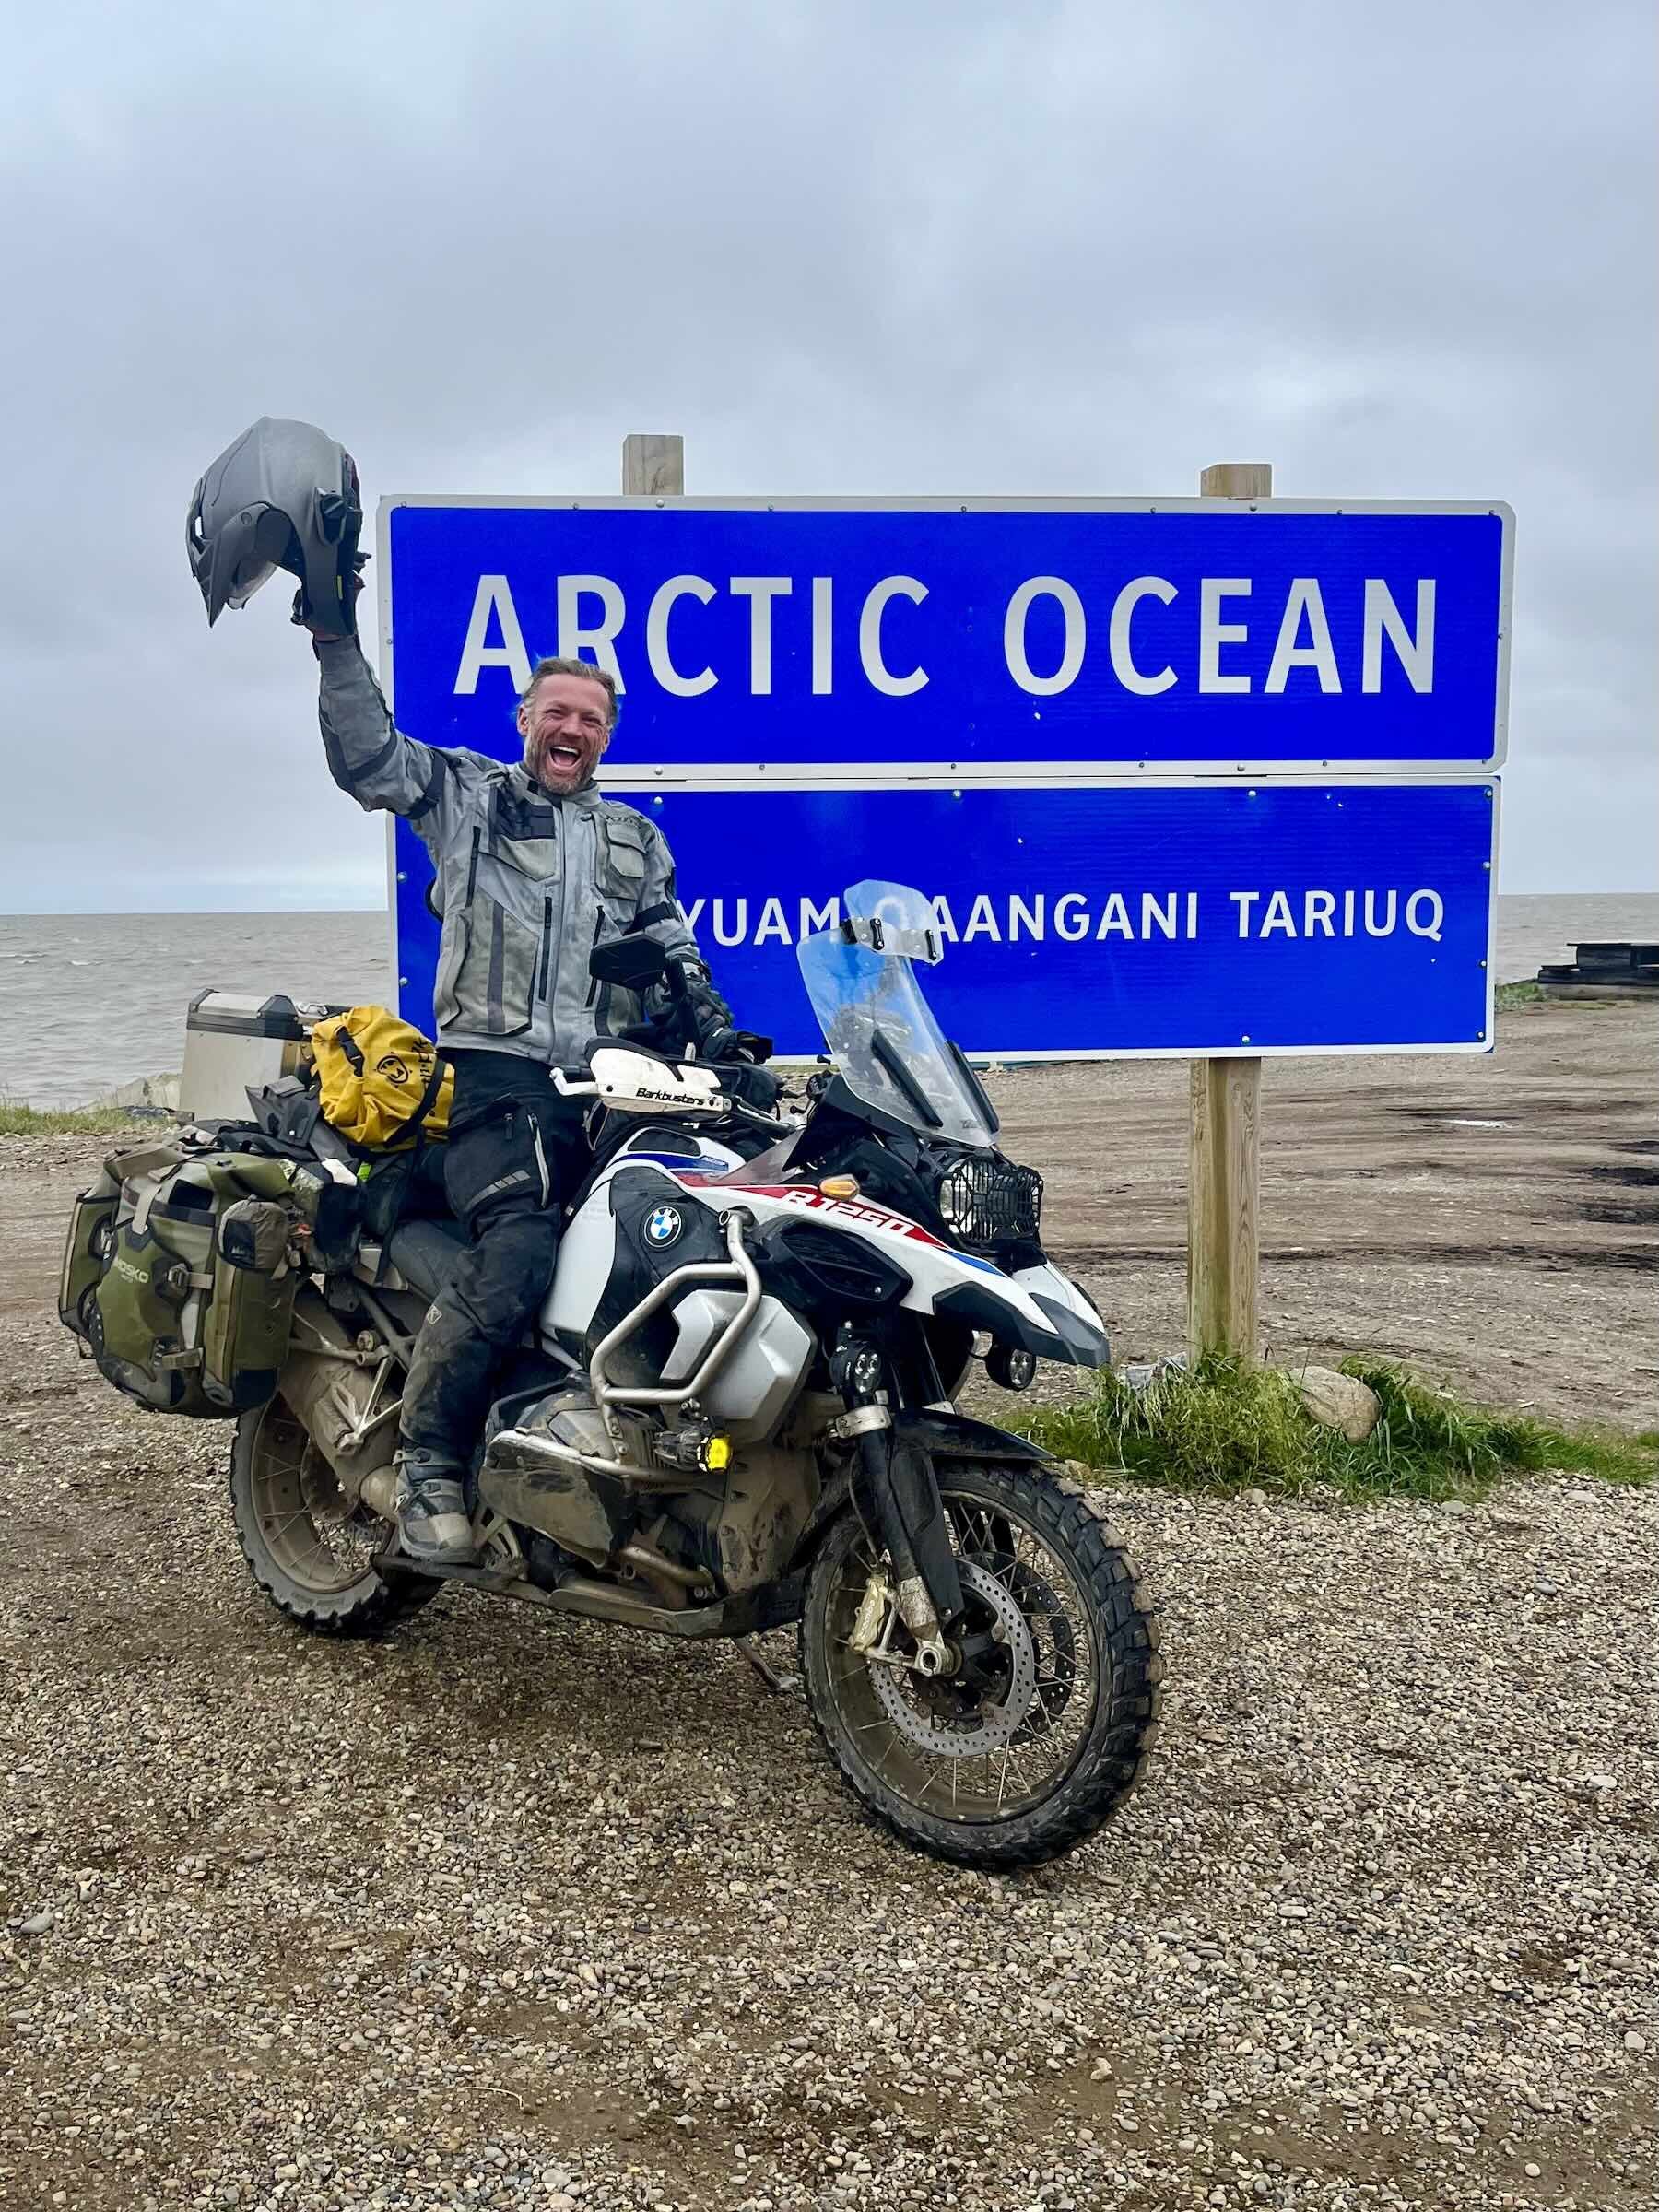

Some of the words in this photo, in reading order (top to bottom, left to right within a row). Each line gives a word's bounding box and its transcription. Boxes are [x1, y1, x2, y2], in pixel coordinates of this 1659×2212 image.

[453, 573, 930, 697] ARCTIC
[1004, 575, 1437, 697] OCEAN
[1230, 888, 1444, 943] TARIUQ
[635, 1087, 706, 1106] Barkbusters
